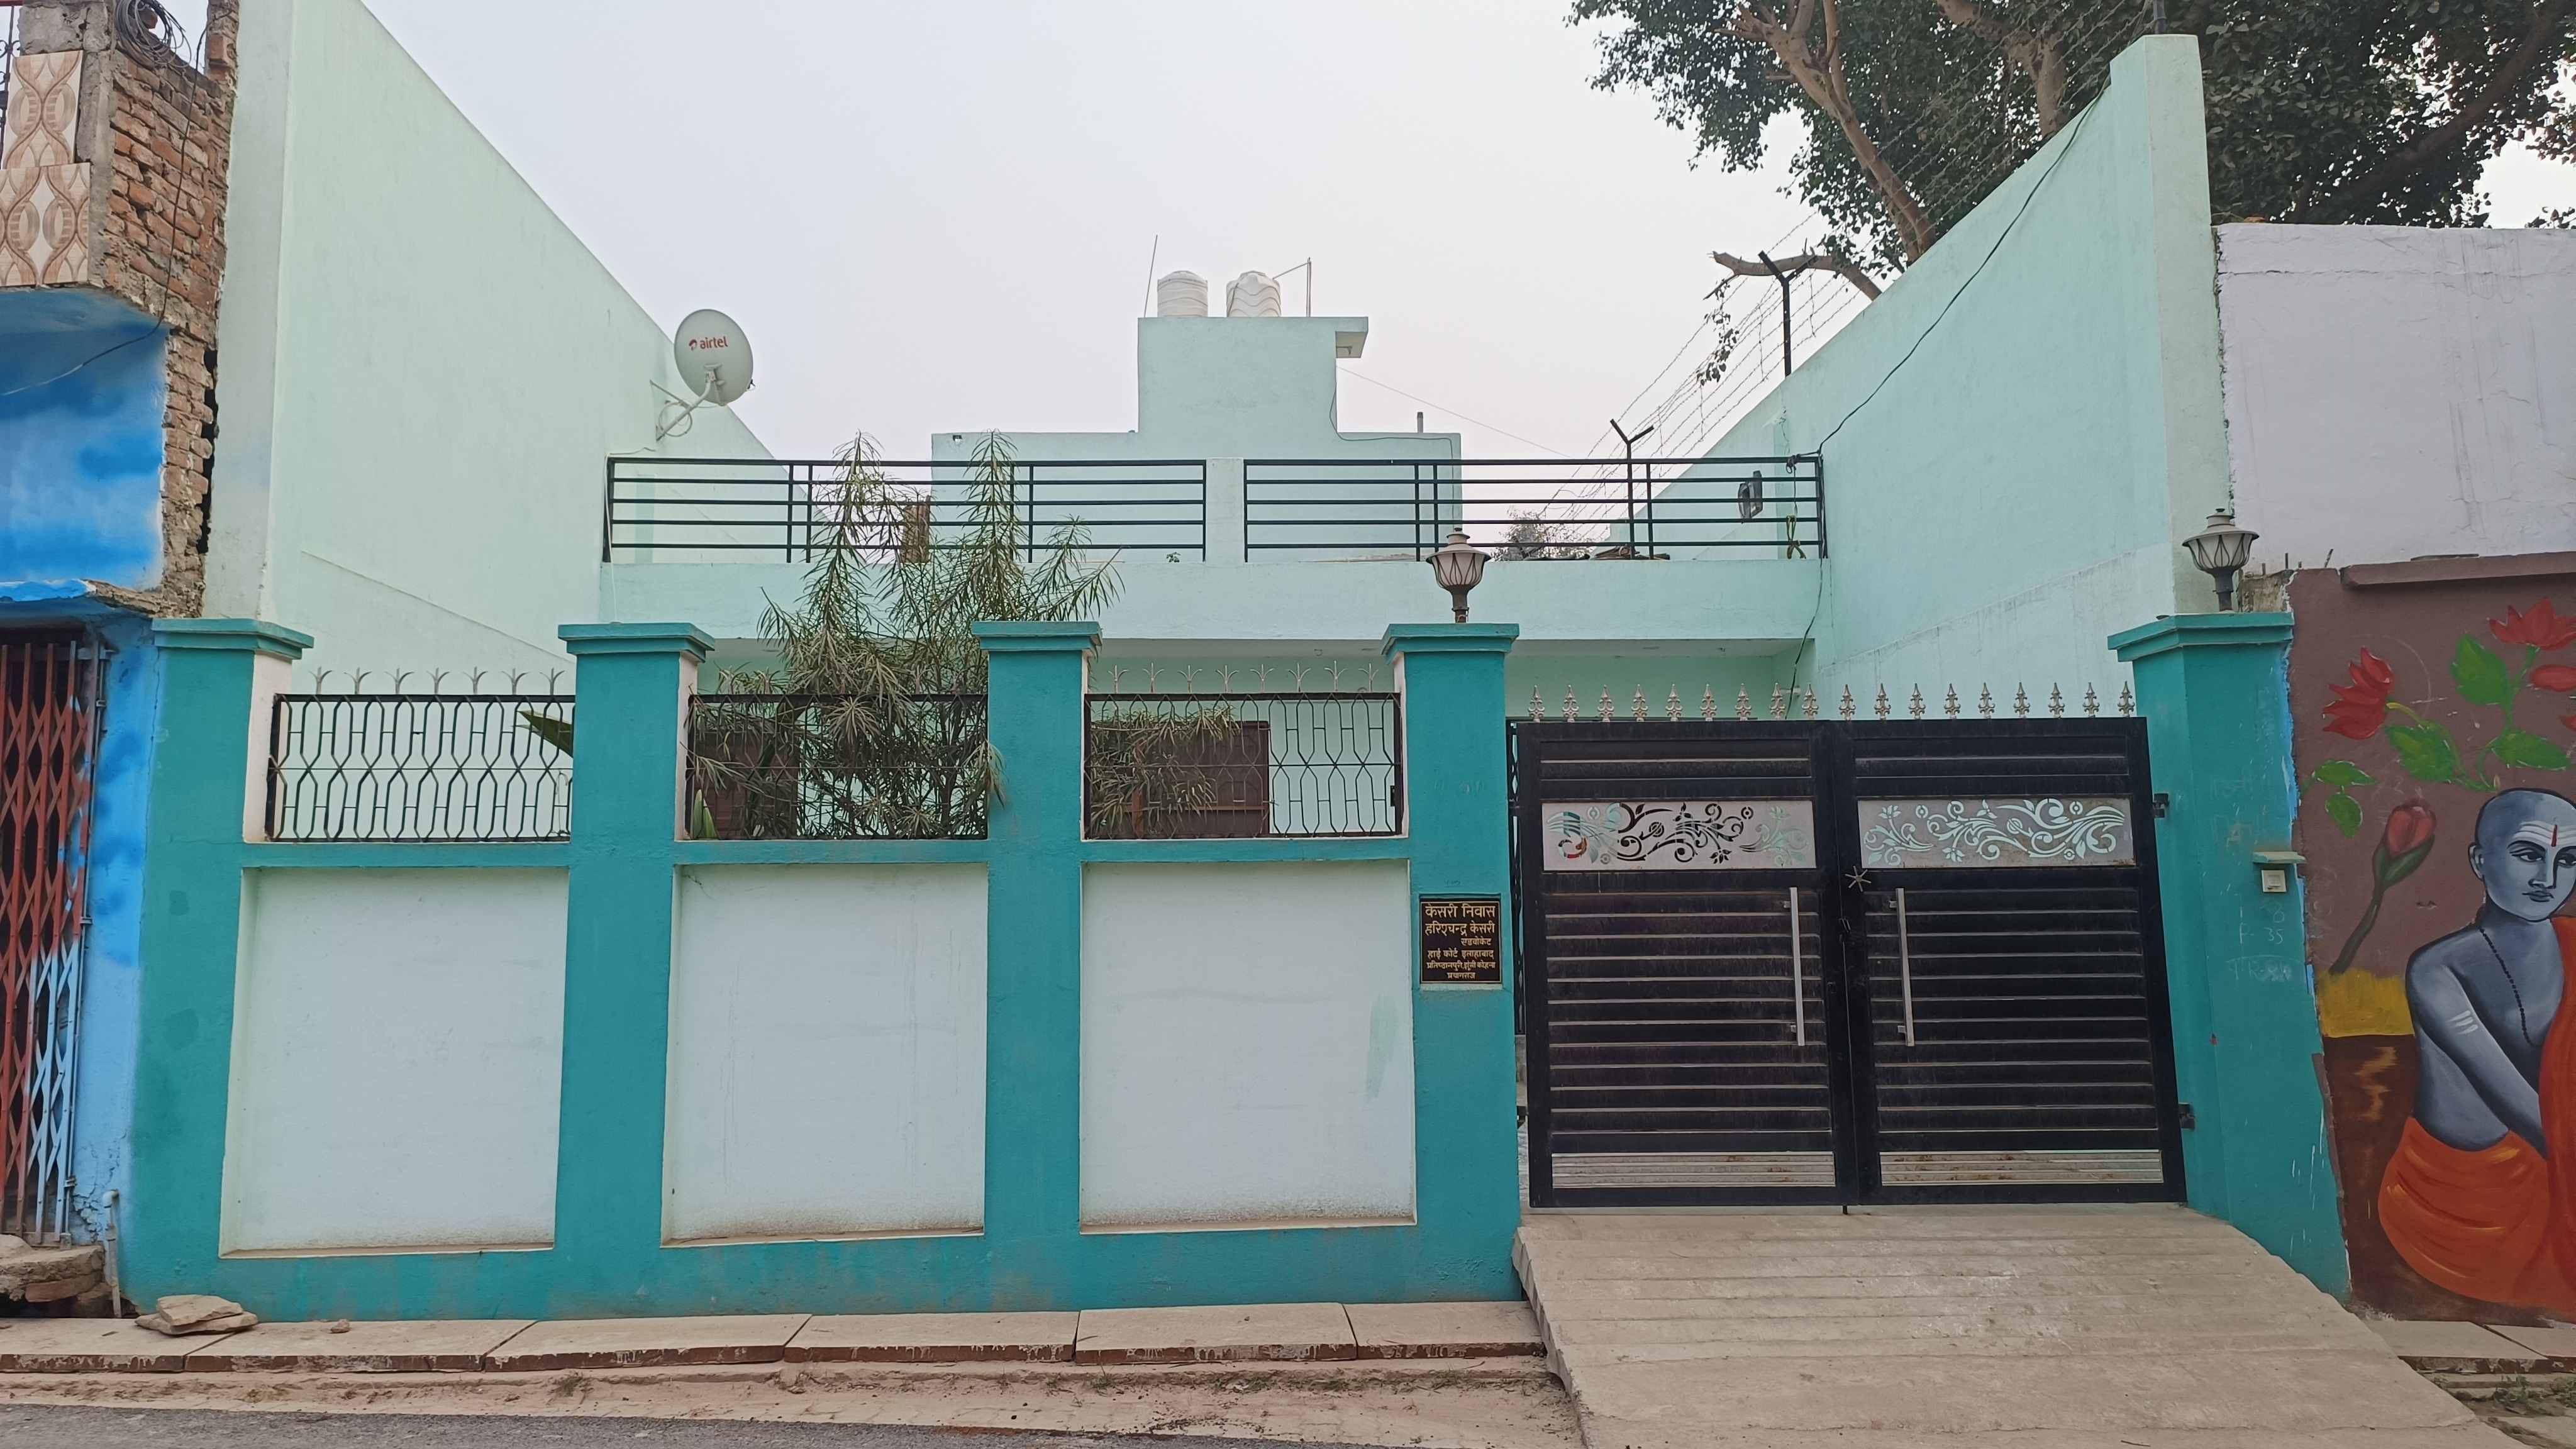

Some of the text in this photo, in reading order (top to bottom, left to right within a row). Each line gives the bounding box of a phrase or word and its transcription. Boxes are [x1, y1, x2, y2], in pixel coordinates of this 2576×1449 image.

[700, 336, 728, 350] airtel
[1424, 903, 1496, 918] केसरी निवास
[1470, 920, 1495, 933] केसरी
[1427, 948, 1441, 959] हाई
[1443, 948, 1458, 957] कोर्ट
